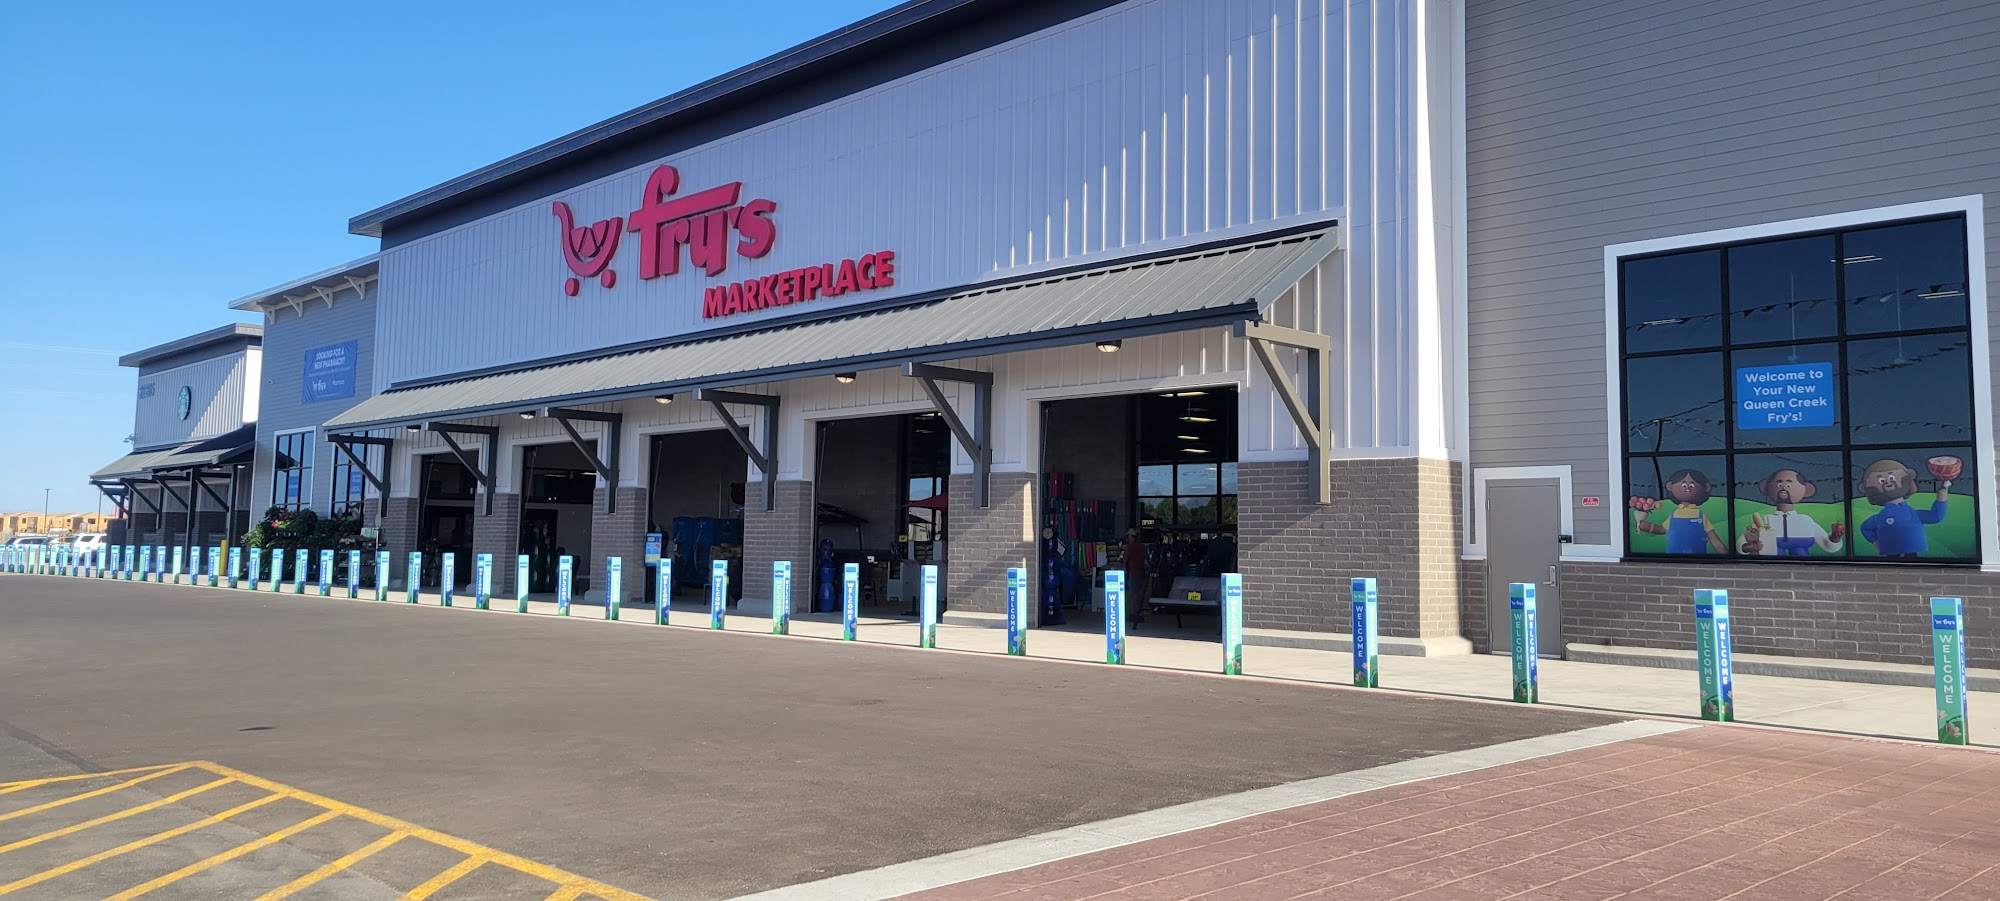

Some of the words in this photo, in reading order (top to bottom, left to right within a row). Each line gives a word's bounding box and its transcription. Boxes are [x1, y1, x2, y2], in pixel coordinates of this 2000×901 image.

[627, 164, 777, 280] fry's
[702, 250, 895, 319] MARKETPLACE
[1744, 400, 1785, 410] Queen
[1788, 396, 1827, 408] Creek
[1745, 372, 1805, 383] Welcome
[1809, 370, 1823, 379] to
[1753, 386, 1783, 396] Your
[1787, 384, 1816, 394] New
[1768, 412, 1802, 424] Fry's!
[1108, 594, 1116, 639] WELCOME
[1514, 613, 1523, 670] WELCOME
[1700, 622, 1712, 684] WELCOME
[1718, 622, 1728, 684] WELCOME
[1939, 634, 1955, 704] WELCOME
